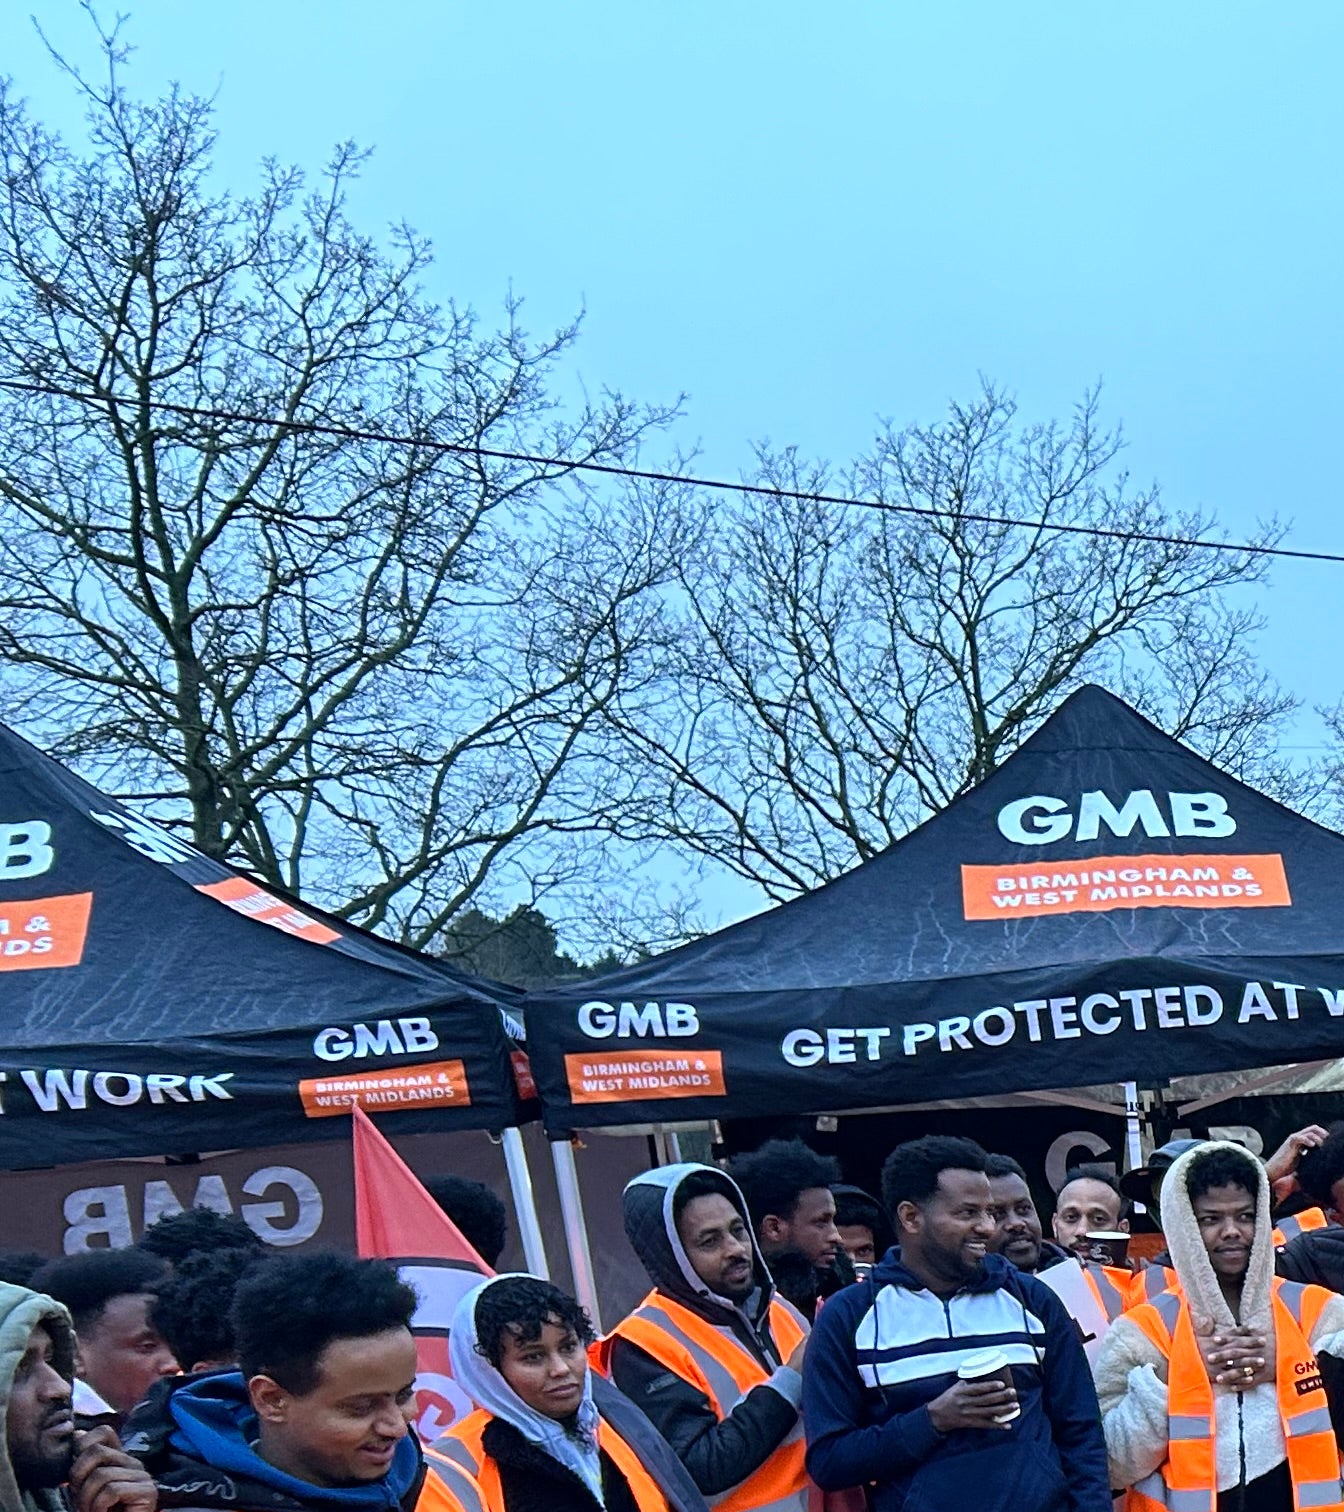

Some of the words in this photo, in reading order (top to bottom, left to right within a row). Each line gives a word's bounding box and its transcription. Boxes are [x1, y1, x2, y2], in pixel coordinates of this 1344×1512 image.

[997, 789, 1237, 845] GMB
[997, 867, 1220, 892] BIRMINGHAM
[1231, 867, 1255, 881] &
[992, 889, 1078, 908] WEST
[1090, 883, 1263, 902] MIDLANDS
[578, 1001, 700, 1038] GMB
[782, 1027, 890, 1067] GET
[903, 985, 1224, 1055] PROTECTED
[1238, 982, 1305, 1024] AT
[313, 1017, 439, 1062] GMB
[583, 1060, 689, 1077] BIRMINGHAM
[695, 1059, 707, 1072] &
[20, 1069, 235, 1112] WORK
[315, 1075, 432, 1093] BIRMINGHAM
[437, 1072, 449, 1084] &
[582, 1078, 624, 1092] WEST
[629, 1074, 712, 1090] MIDLANDS
[315, 1092, 359, 1107] WEST
[366, 1085, 455, 1104] MIDLANDS
